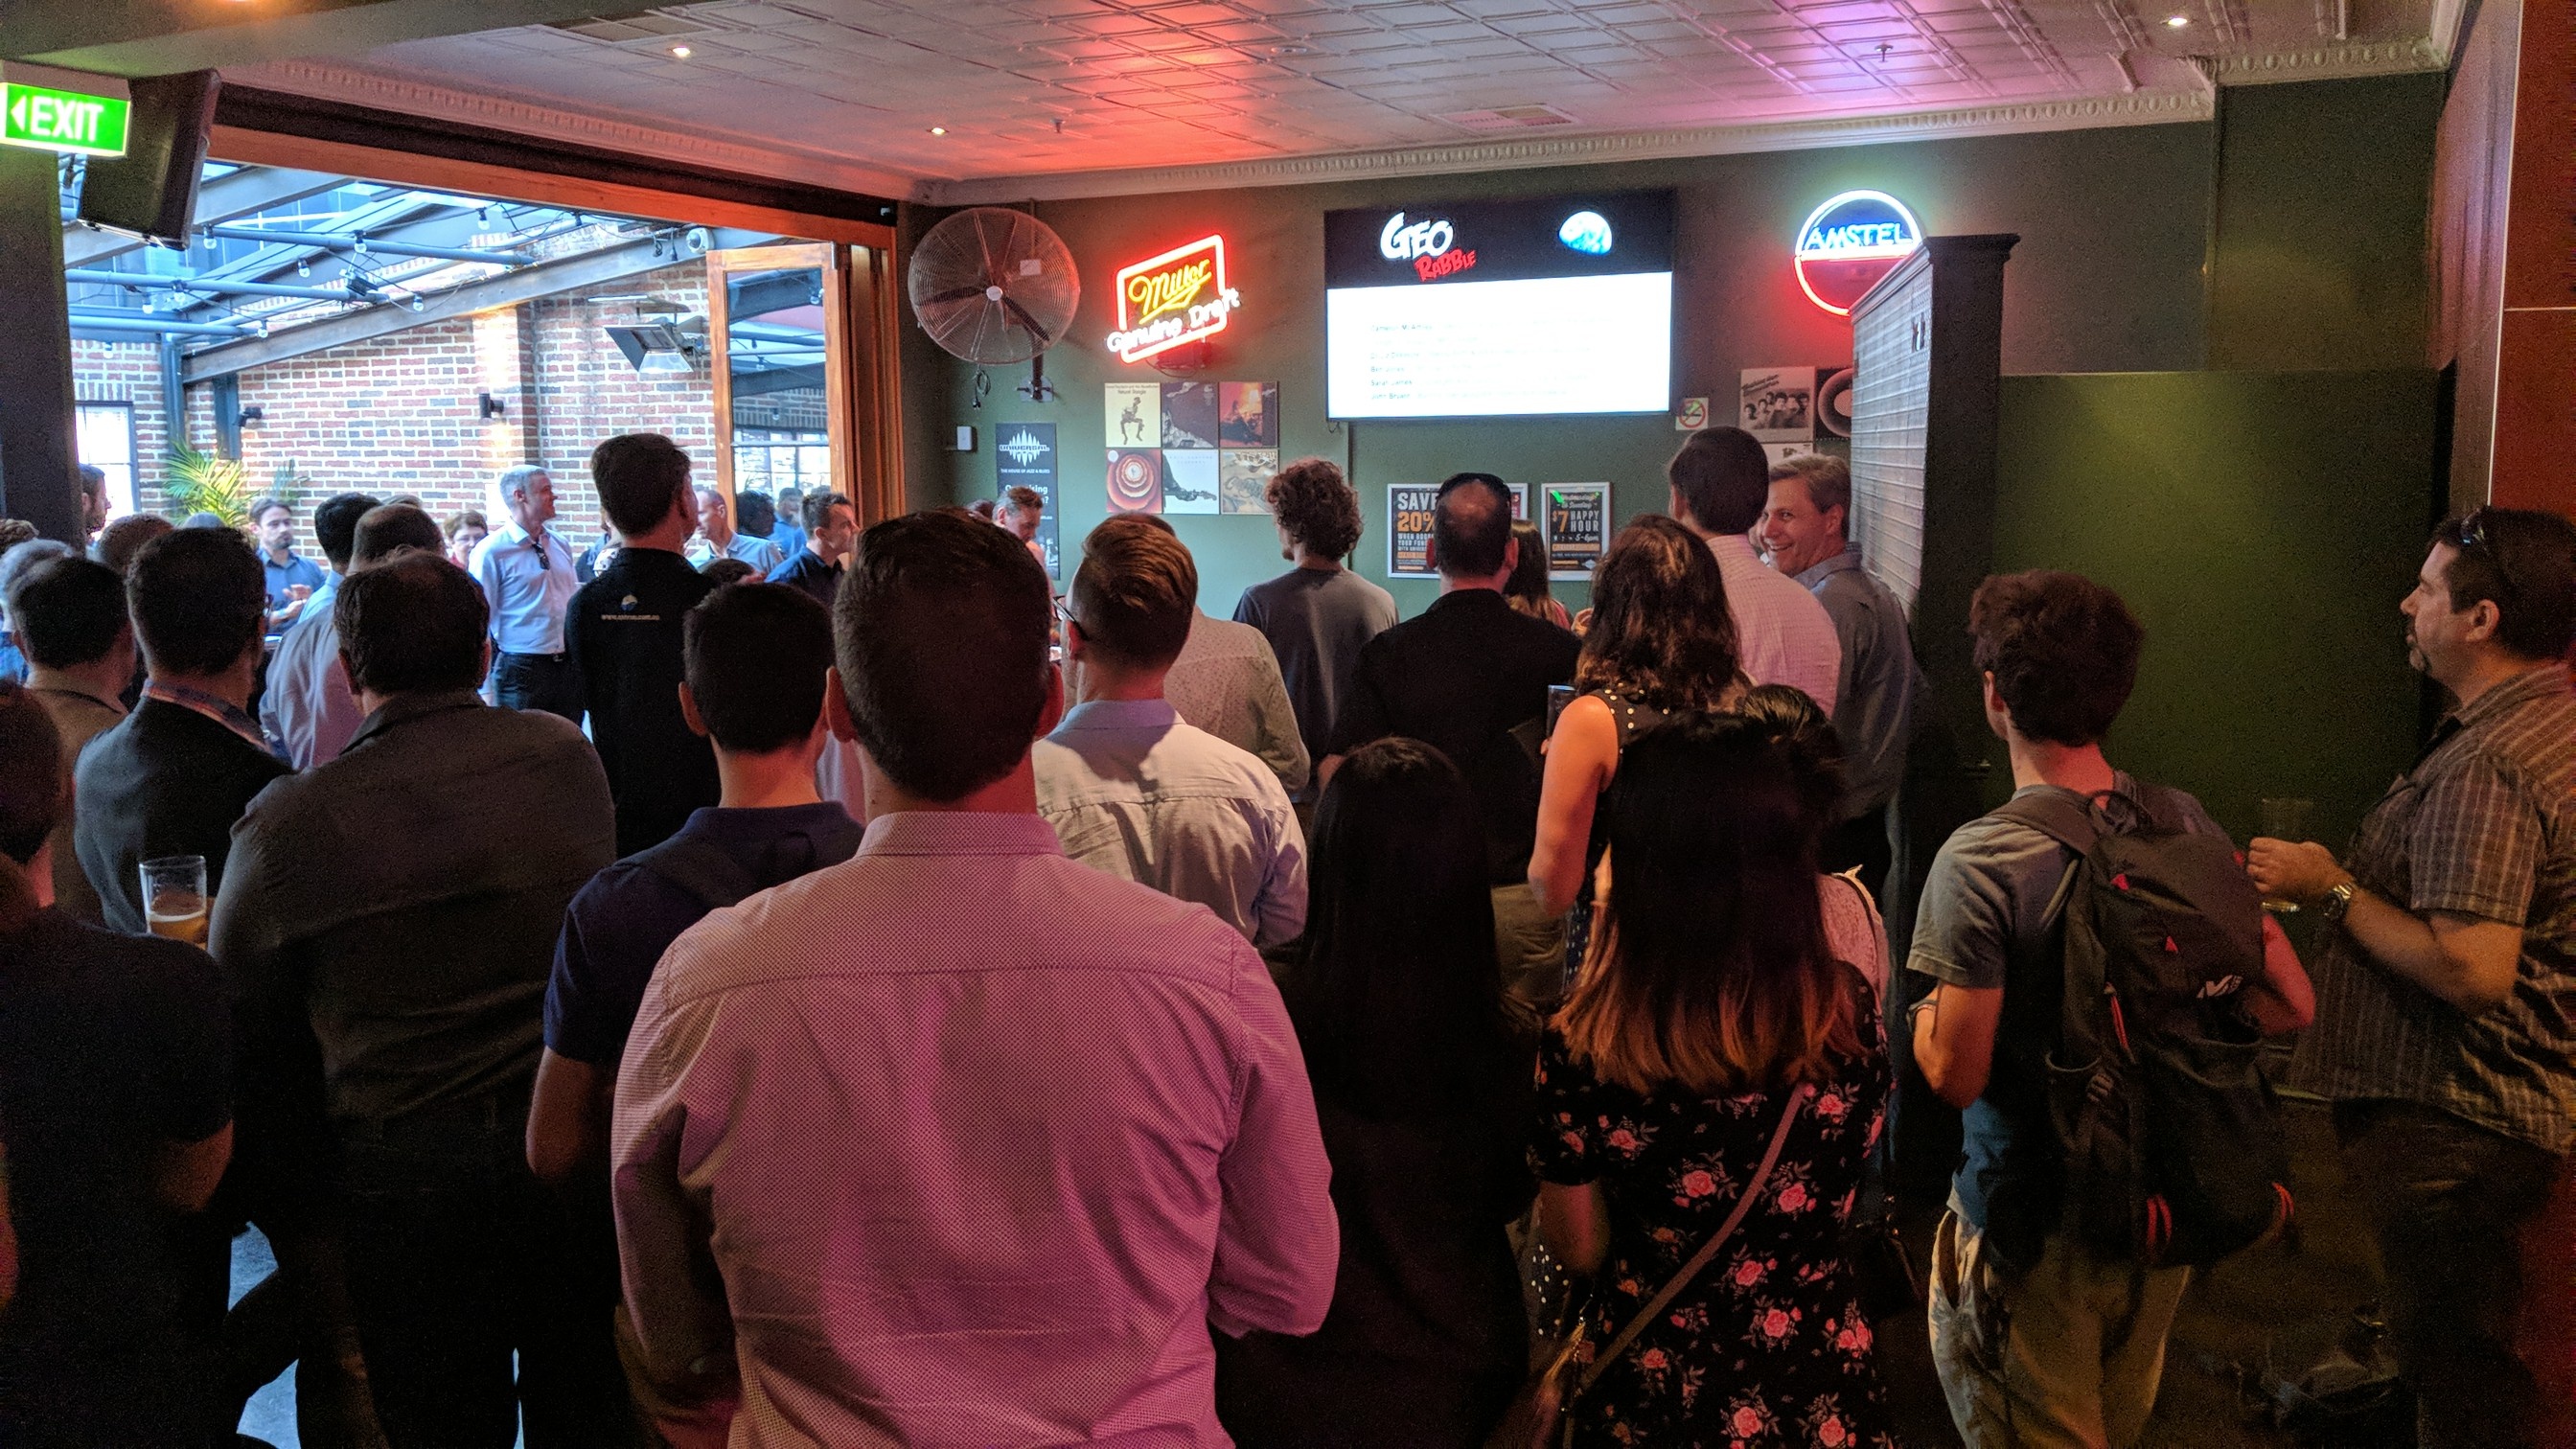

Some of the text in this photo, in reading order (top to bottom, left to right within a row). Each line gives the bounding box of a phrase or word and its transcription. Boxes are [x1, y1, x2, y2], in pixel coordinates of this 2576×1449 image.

[30, 95, 104, 142] EXIT
[1380, 212, 1455, 260] GEO
[1804, 221, 1912, 251] AMSTEL
[1128, 258, 1210, 316] Miller
[1187, 287, 1241, 328] Draft
[1570, 510, 1599, 520] HAPPY
[1570, 520, 1599, 533] HOUR
